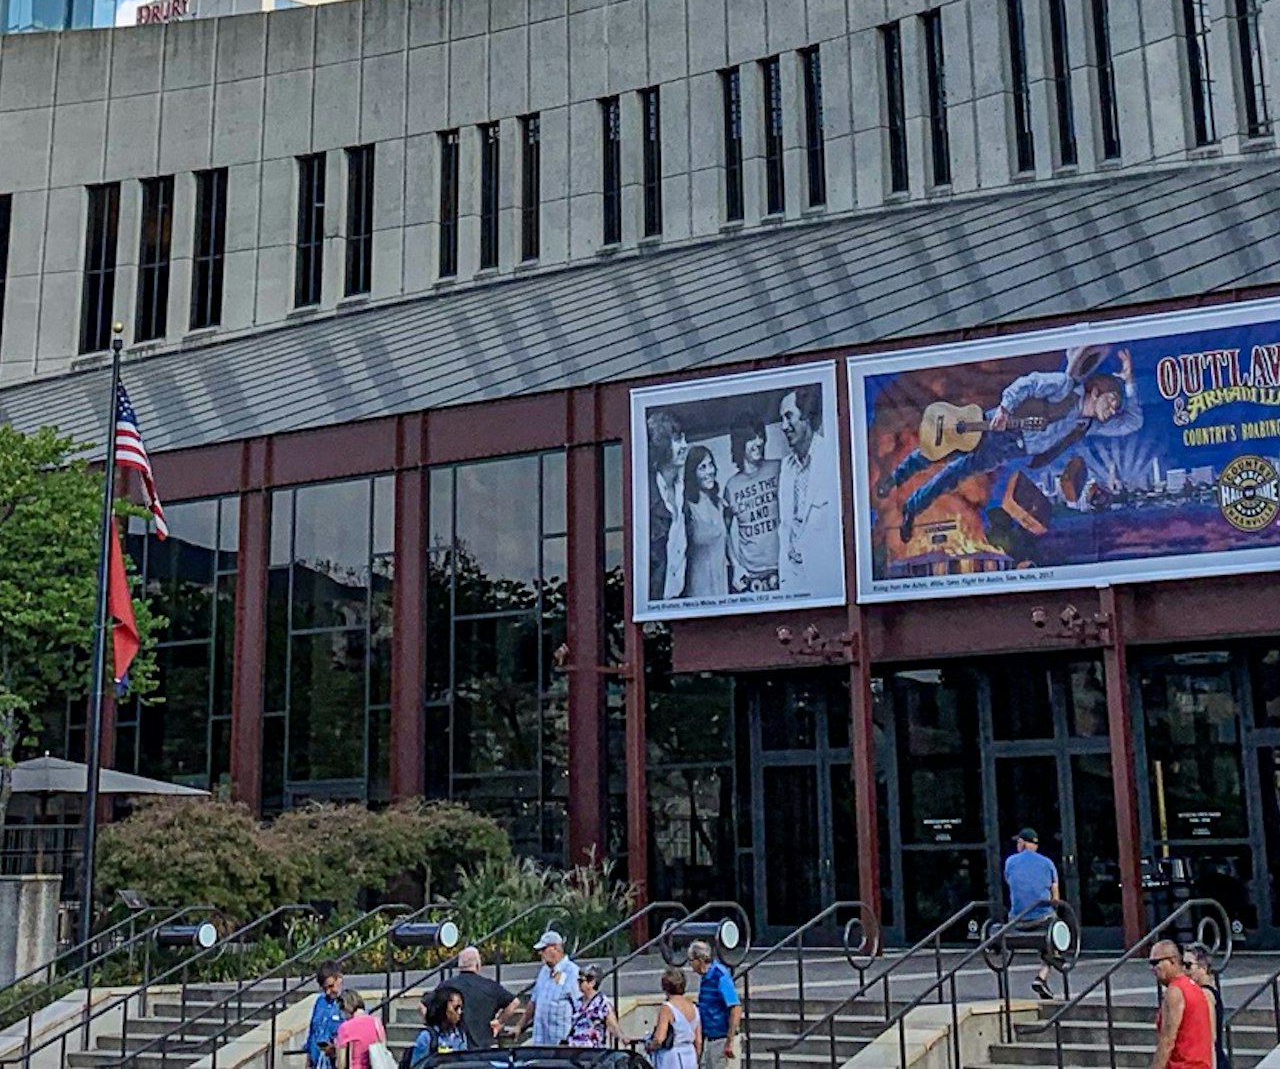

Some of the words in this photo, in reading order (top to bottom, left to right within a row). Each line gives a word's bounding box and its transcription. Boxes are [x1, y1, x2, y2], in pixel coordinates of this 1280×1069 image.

[1183, 423, 1237, 447] COUNTRY'S
[1226, 460, 1273, 482] COUNTRY
[735, 484, 757, 503] PASS
[758, 476, 778, 492] THE
[738, 490, 778, 514] CHICKEN
[750, 505, 770, 522] AND
